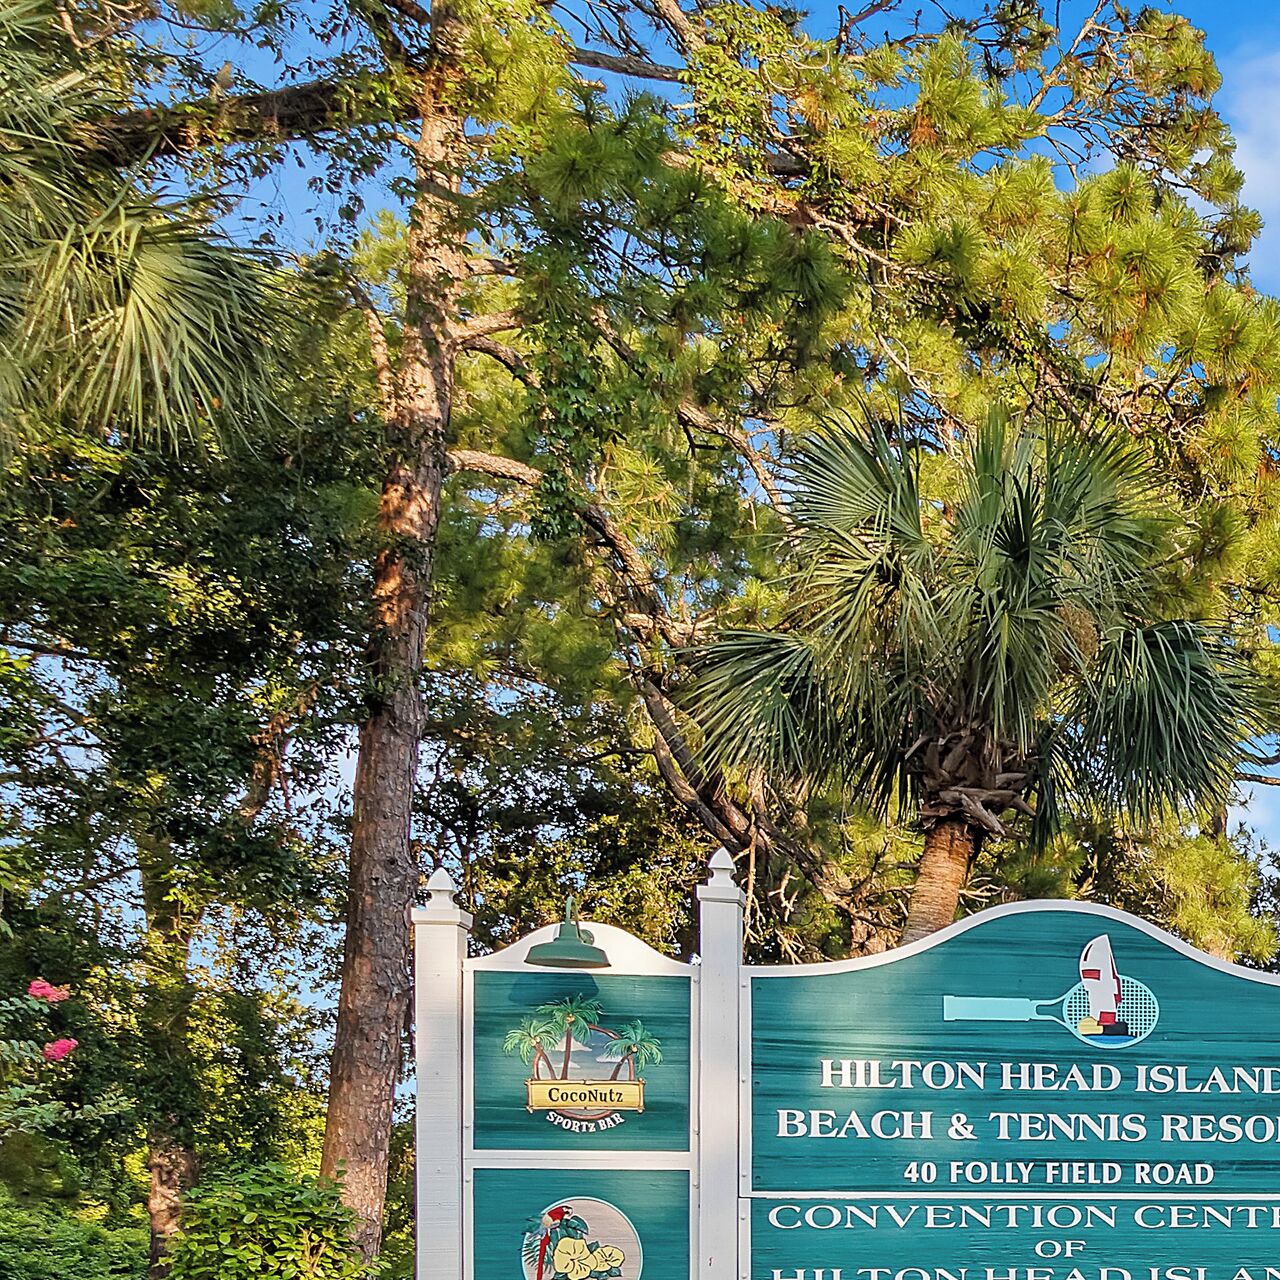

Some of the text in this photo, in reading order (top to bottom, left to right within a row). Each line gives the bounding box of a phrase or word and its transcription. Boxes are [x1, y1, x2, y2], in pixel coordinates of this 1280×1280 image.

[820, 1059, 988, 1090] HILTON
[1000, 1062, 1122, 1092] HEAD
[548, 1087, 624, 1102] CocoNutz
[597, 1112, 625, 1131] BAR
[776, 1109, 934, 1139] BEACH
[947, 1113, 978, 1140] &
[989, 1111, 1148, 1142] TENNIS
[903, 1161, 1215, 1185] 40 FOLLY FIELD ROAD
[768, 1205, 1118, 1229] CONVENTION
[1035, 1240, 1087, 1258] OF
